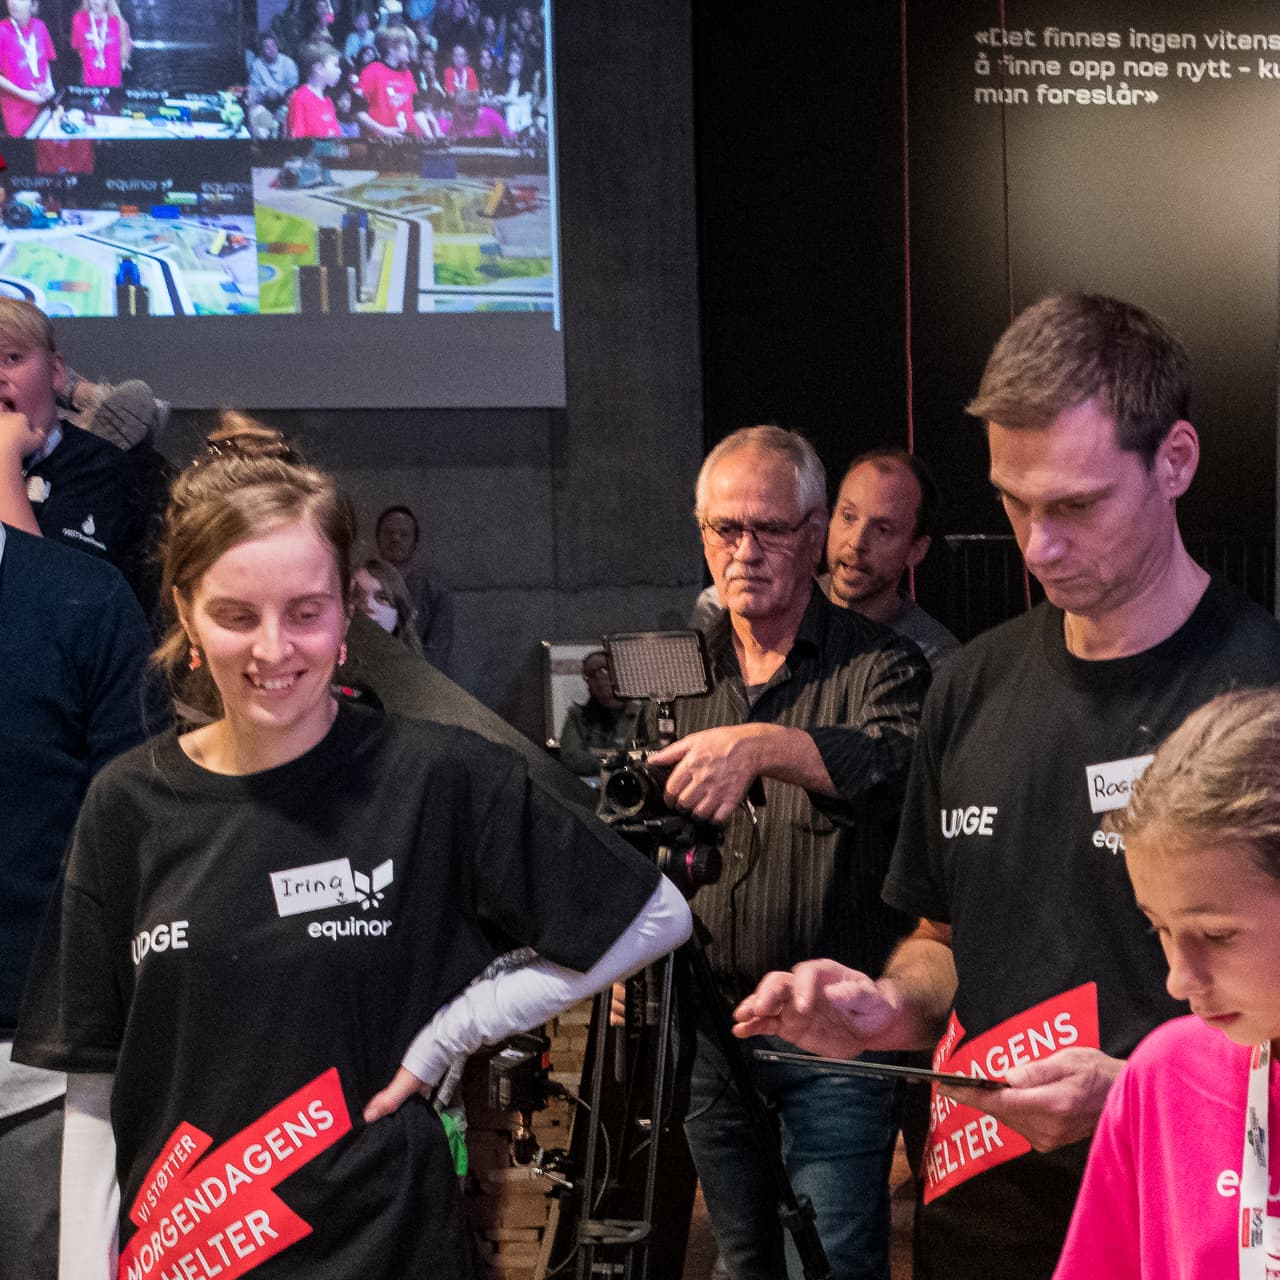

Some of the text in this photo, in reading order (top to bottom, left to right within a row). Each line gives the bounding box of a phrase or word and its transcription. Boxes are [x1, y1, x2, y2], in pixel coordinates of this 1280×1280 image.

[1043, 26, 1121, 48] finnes
[1129, 27, 1197, 53] ingen
[974, 51, 991, 76] å
[1070, 59, 1116, 81] opp
[1123, 60, 1169, 78] noe
[1177, 58, 1233, 83] nytt
[941, 805, 999, 839] UDGE
[280, 874, 344, 897] Irina
[130, 919, 190, 966] UDGE
[307, 916, 393, 942] equinor
[926, 1114, 1004, 1189] HELTER
[137, 1133, 197, 1225] VI STØTTER
